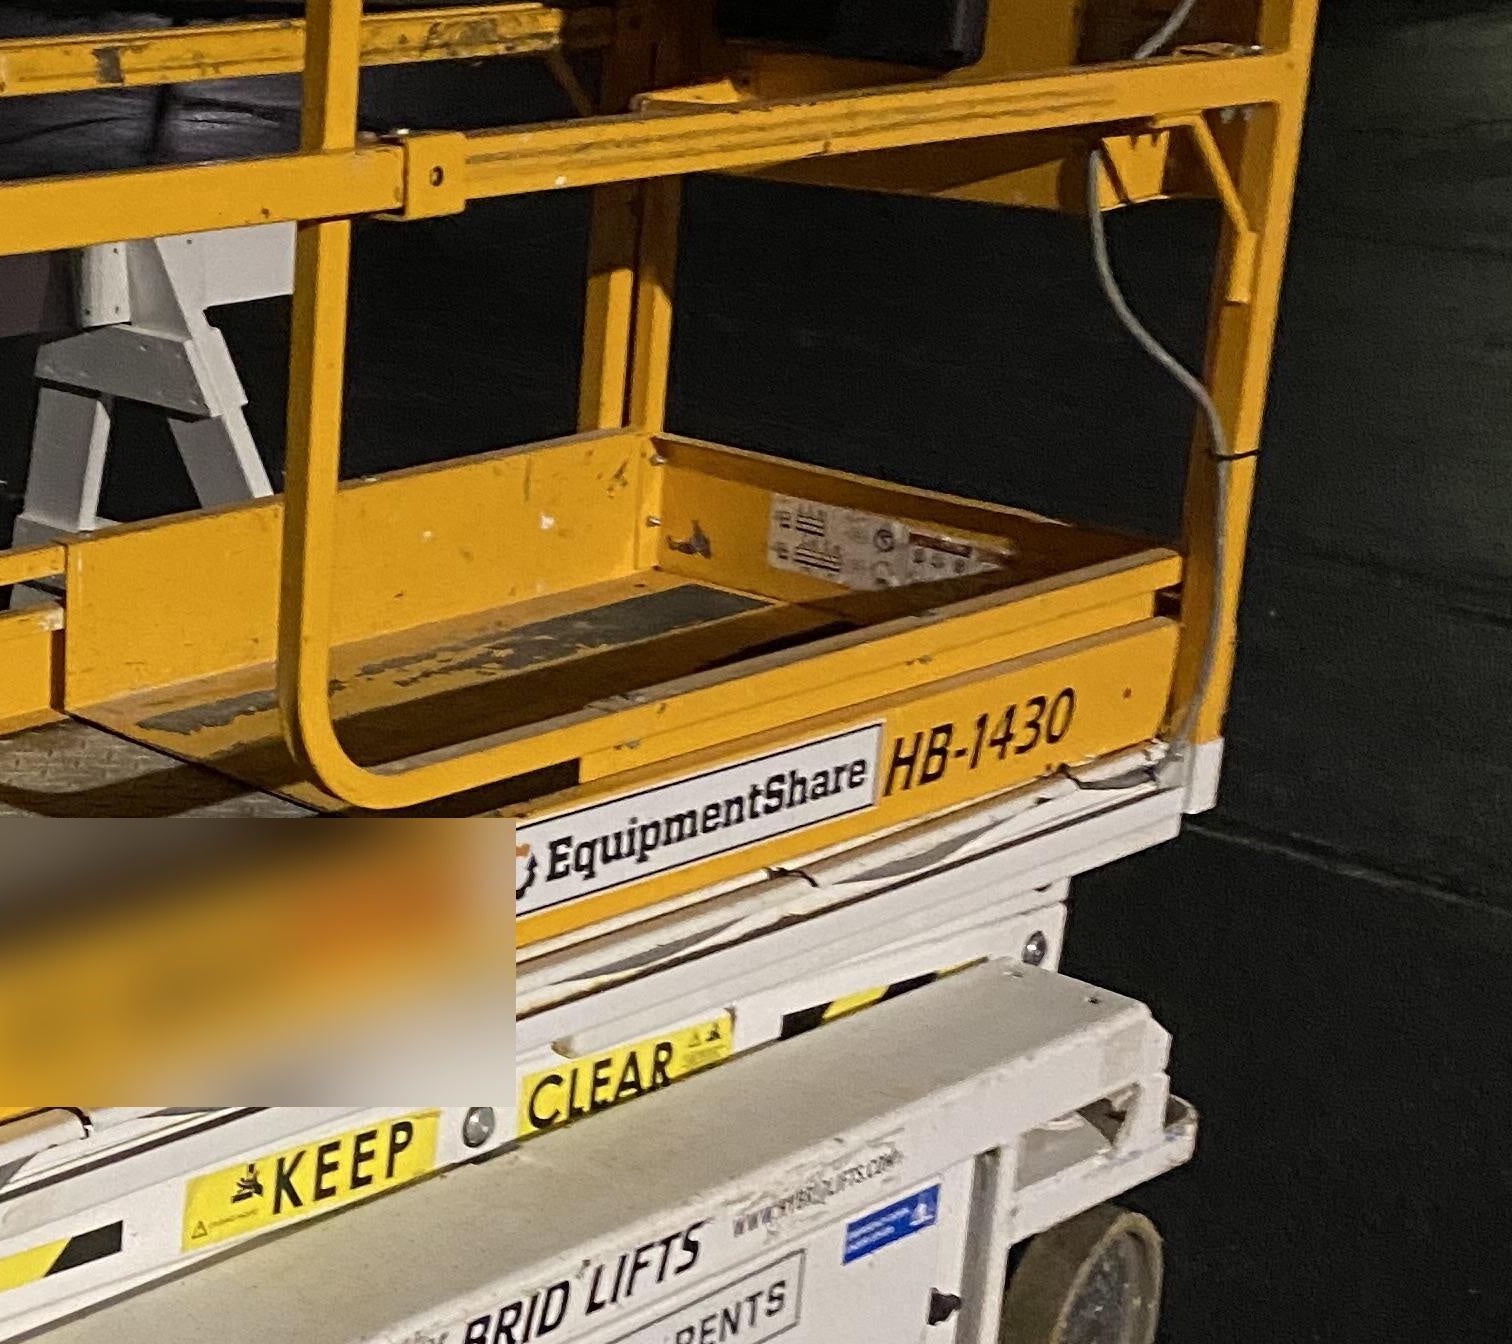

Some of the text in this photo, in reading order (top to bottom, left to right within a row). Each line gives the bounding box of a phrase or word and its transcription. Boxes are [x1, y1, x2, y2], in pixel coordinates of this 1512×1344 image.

[884, 687, 1076, 798] HB-1430
[546, 757, 868, 883] EquipmentShare
[273, 1041, 673, 1215] KEEP CLEAR
[586, 1219, 711, 1314] LIFTS
